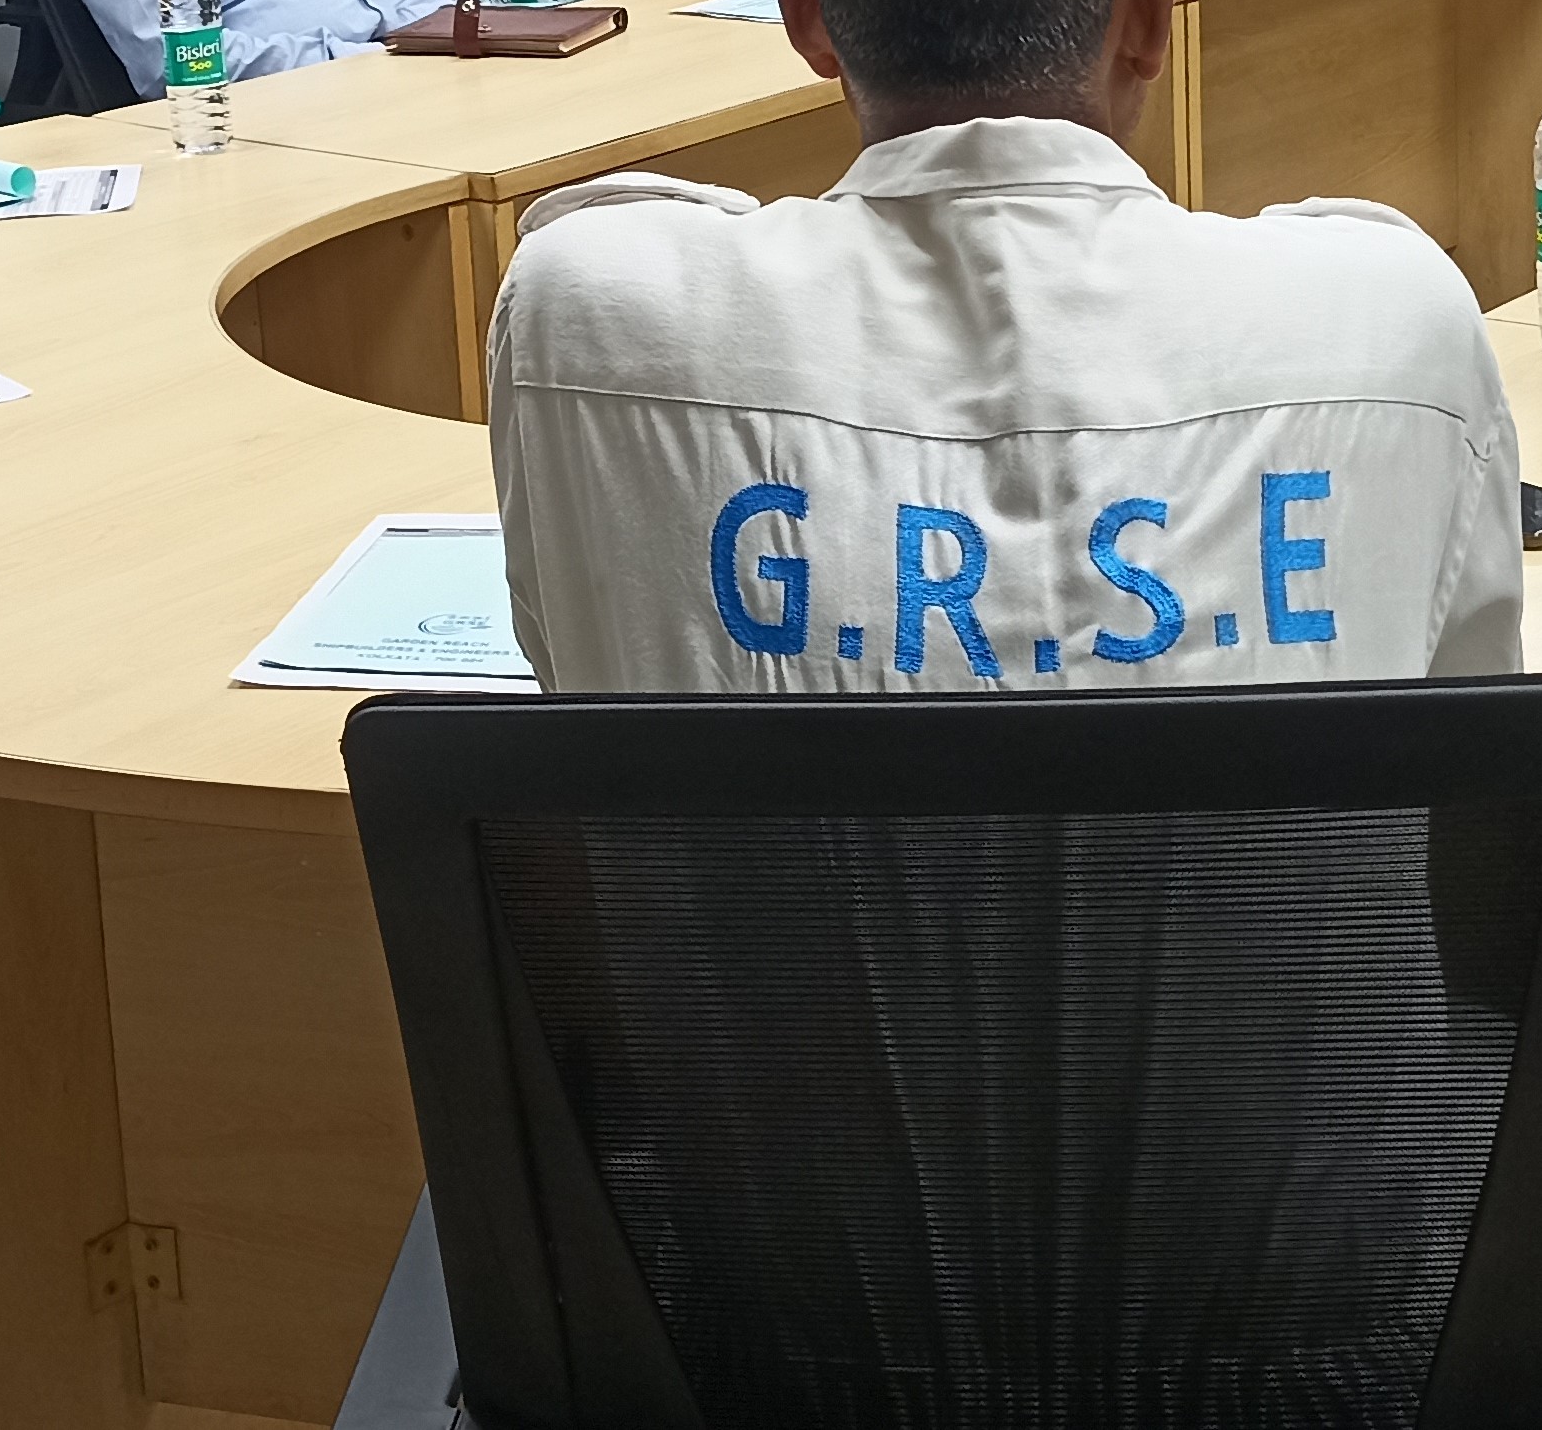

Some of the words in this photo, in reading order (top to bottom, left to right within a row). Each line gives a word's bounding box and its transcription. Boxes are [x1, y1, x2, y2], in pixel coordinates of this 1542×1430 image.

[176, 38, 221, 63] Bisleri
[711, 471, 1337, 679] G.R.S.E
[314, 642, 414, 653] SHIPBUILDERS
[431, 647, 510, 657] ENGINEERS
[381, 637, 438, 646] GARDEN
[443, 640, 490, 648] REACH
